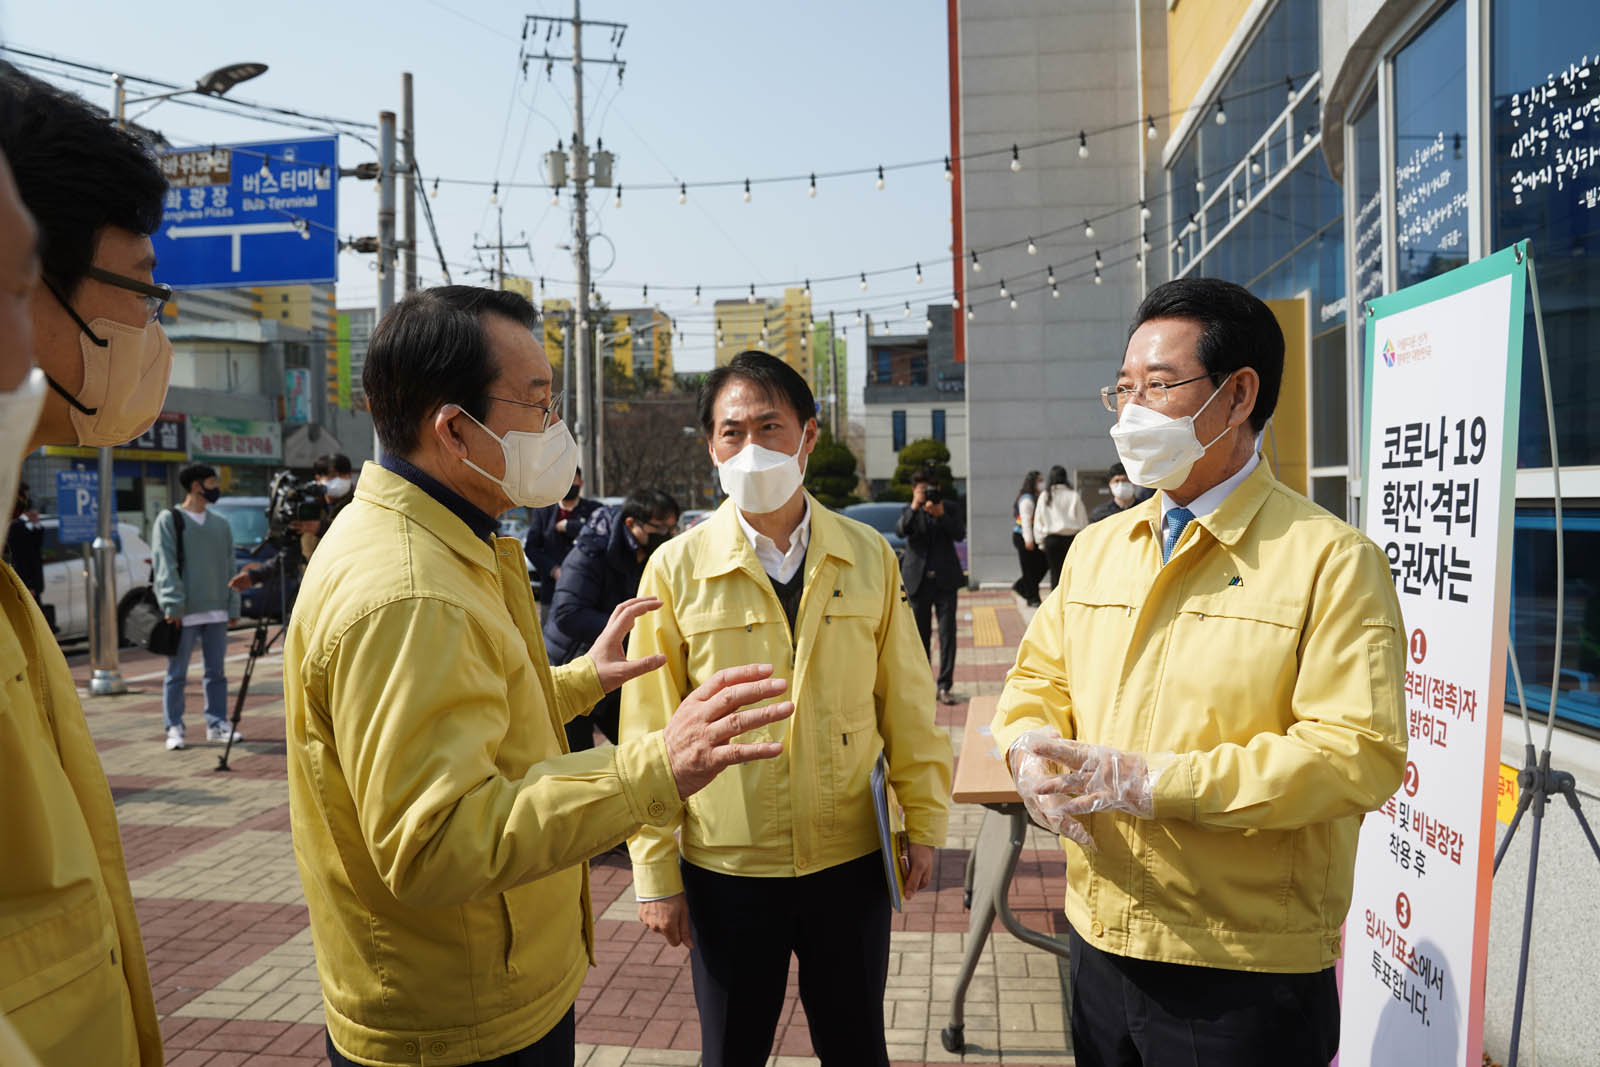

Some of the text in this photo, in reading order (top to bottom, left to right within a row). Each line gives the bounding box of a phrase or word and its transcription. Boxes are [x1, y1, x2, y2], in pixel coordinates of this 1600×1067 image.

[1561, 55, 1591, 95] 작은
[1510, 116, 1549, 158] 시작을
[242, 167, 331, 194] 버스터미널
[1510, 146, 1600, 205] 끝까지 충실하
[268, 194, 318, 209] Terminal
[1382, 416, 1486, 472] 코로나 19
[1382, 478, 1480, 538] 확진·격리
[1410, 708, 1447, 748] 밝히고
[1389, 832, 1426, 879] 착용 후
[1400, 802, 1410, 832] 및
[1413, 809, 1463, 865] 비닐장갑
[1365, 908, 1444, 1001] 임시기표소에서
[1371, 950, 1430, 1027] 투표합니다.
